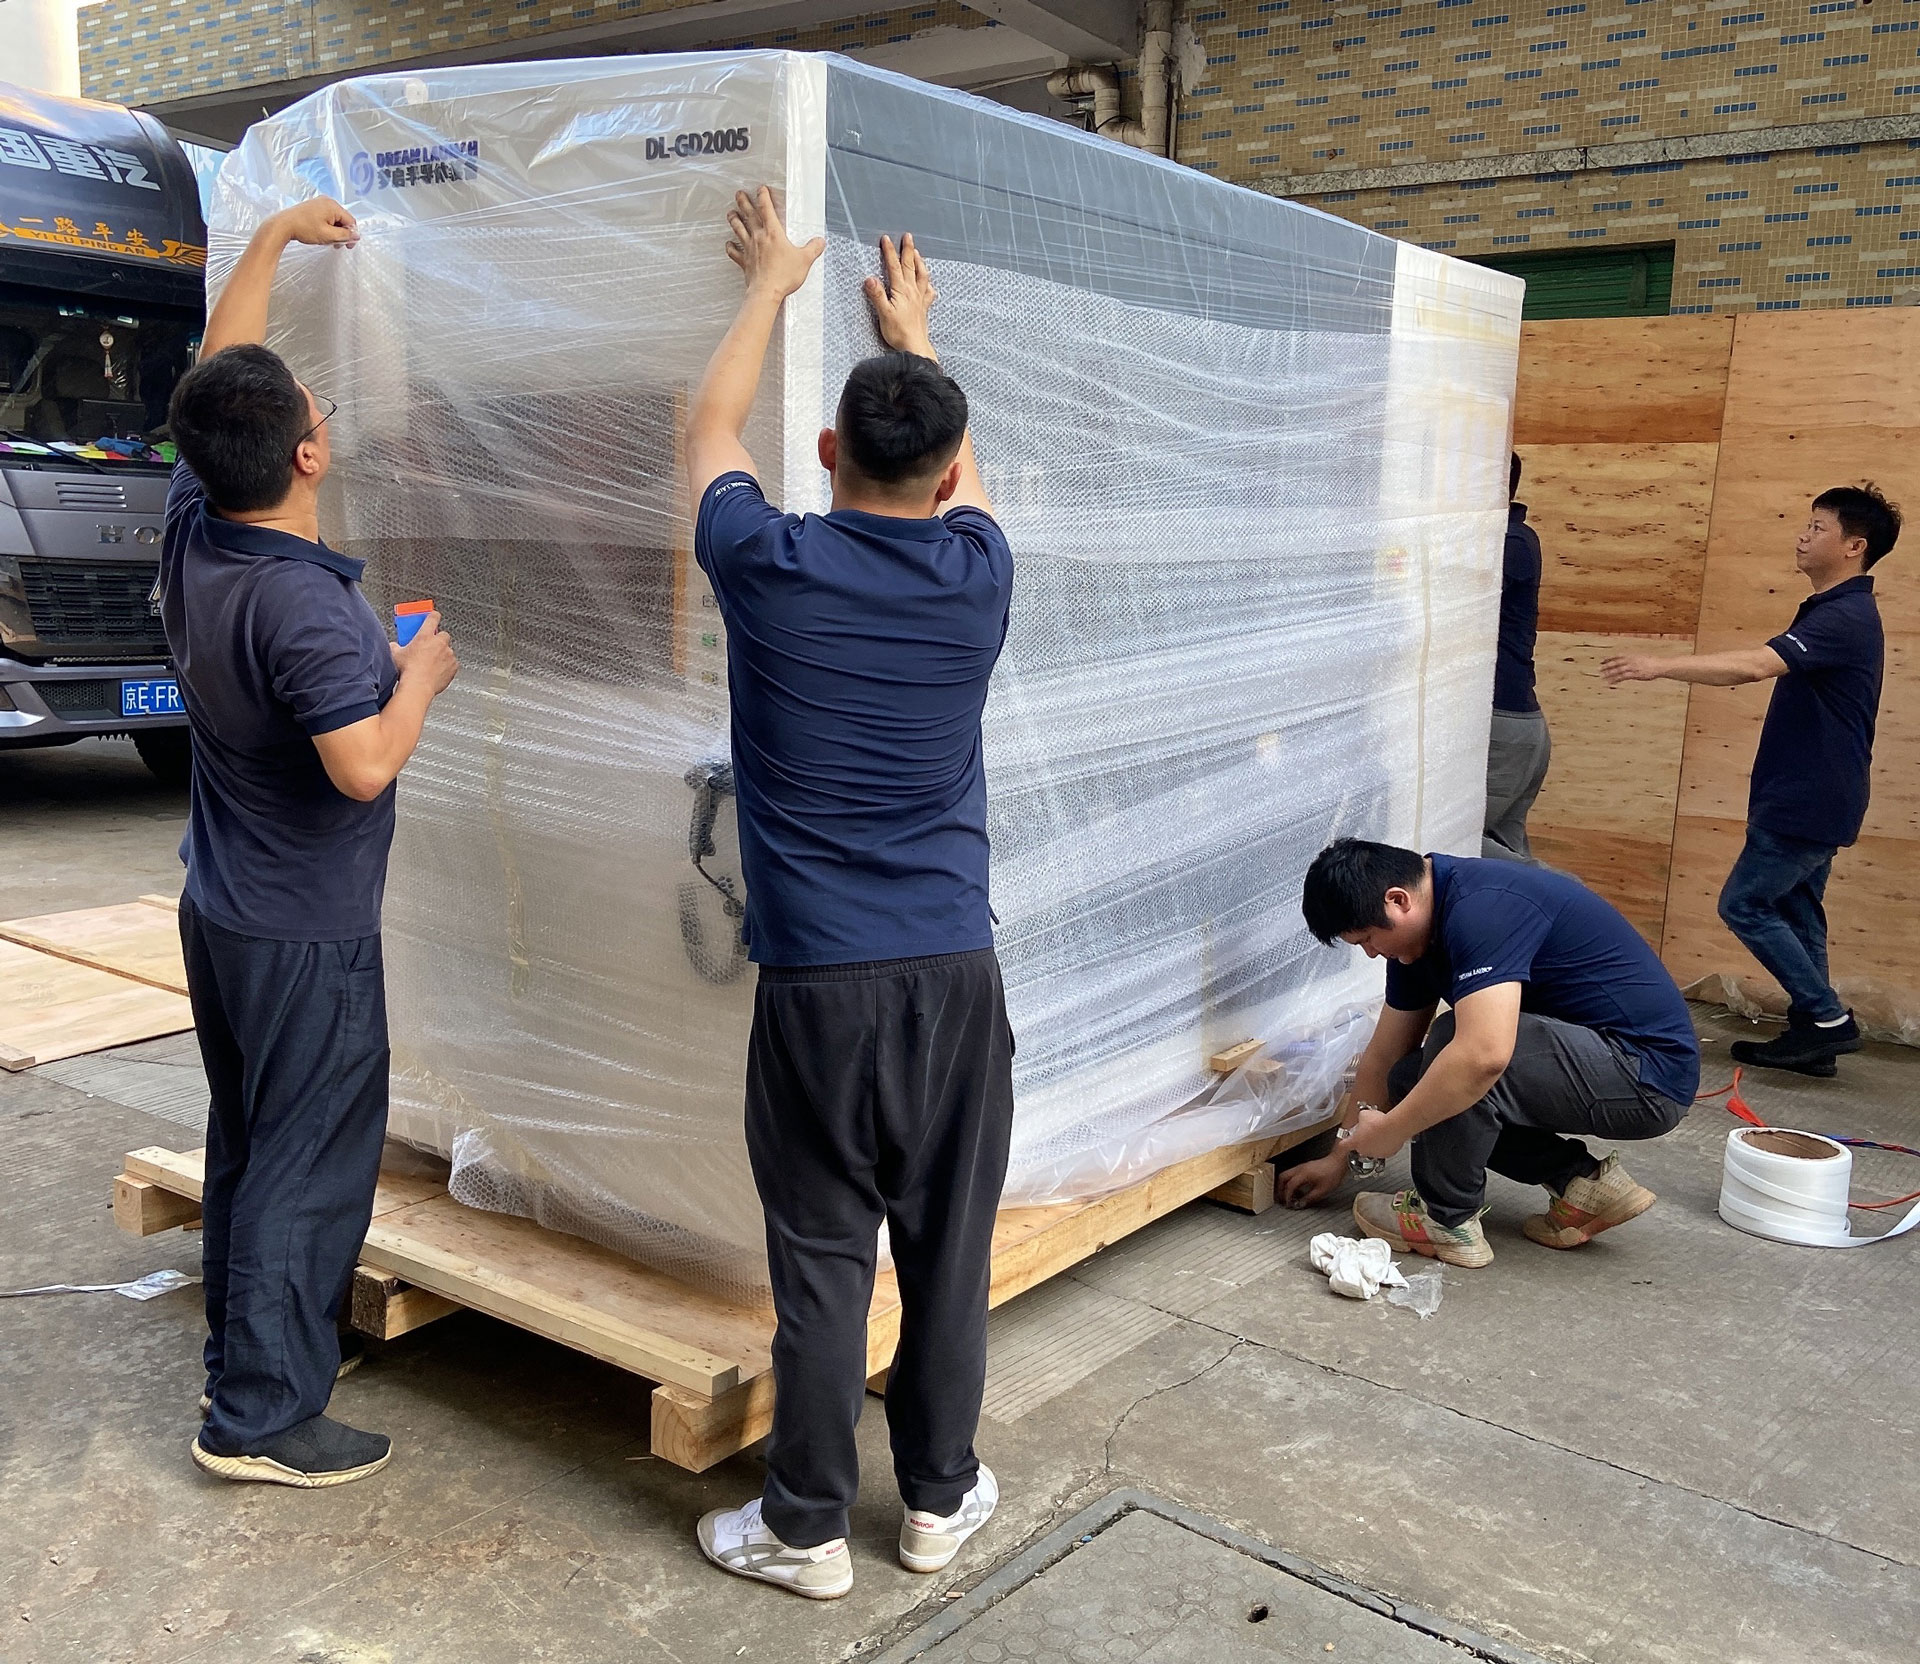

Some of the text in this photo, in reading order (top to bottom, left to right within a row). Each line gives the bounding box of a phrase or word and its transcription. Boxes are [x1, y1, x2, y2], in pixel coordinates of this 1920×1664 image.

[645, 127, 749, 160] DL-GD2005
[19, 217, 149, 249] 一路平安
[30, 231, 145, 255] YI LU PING AN
